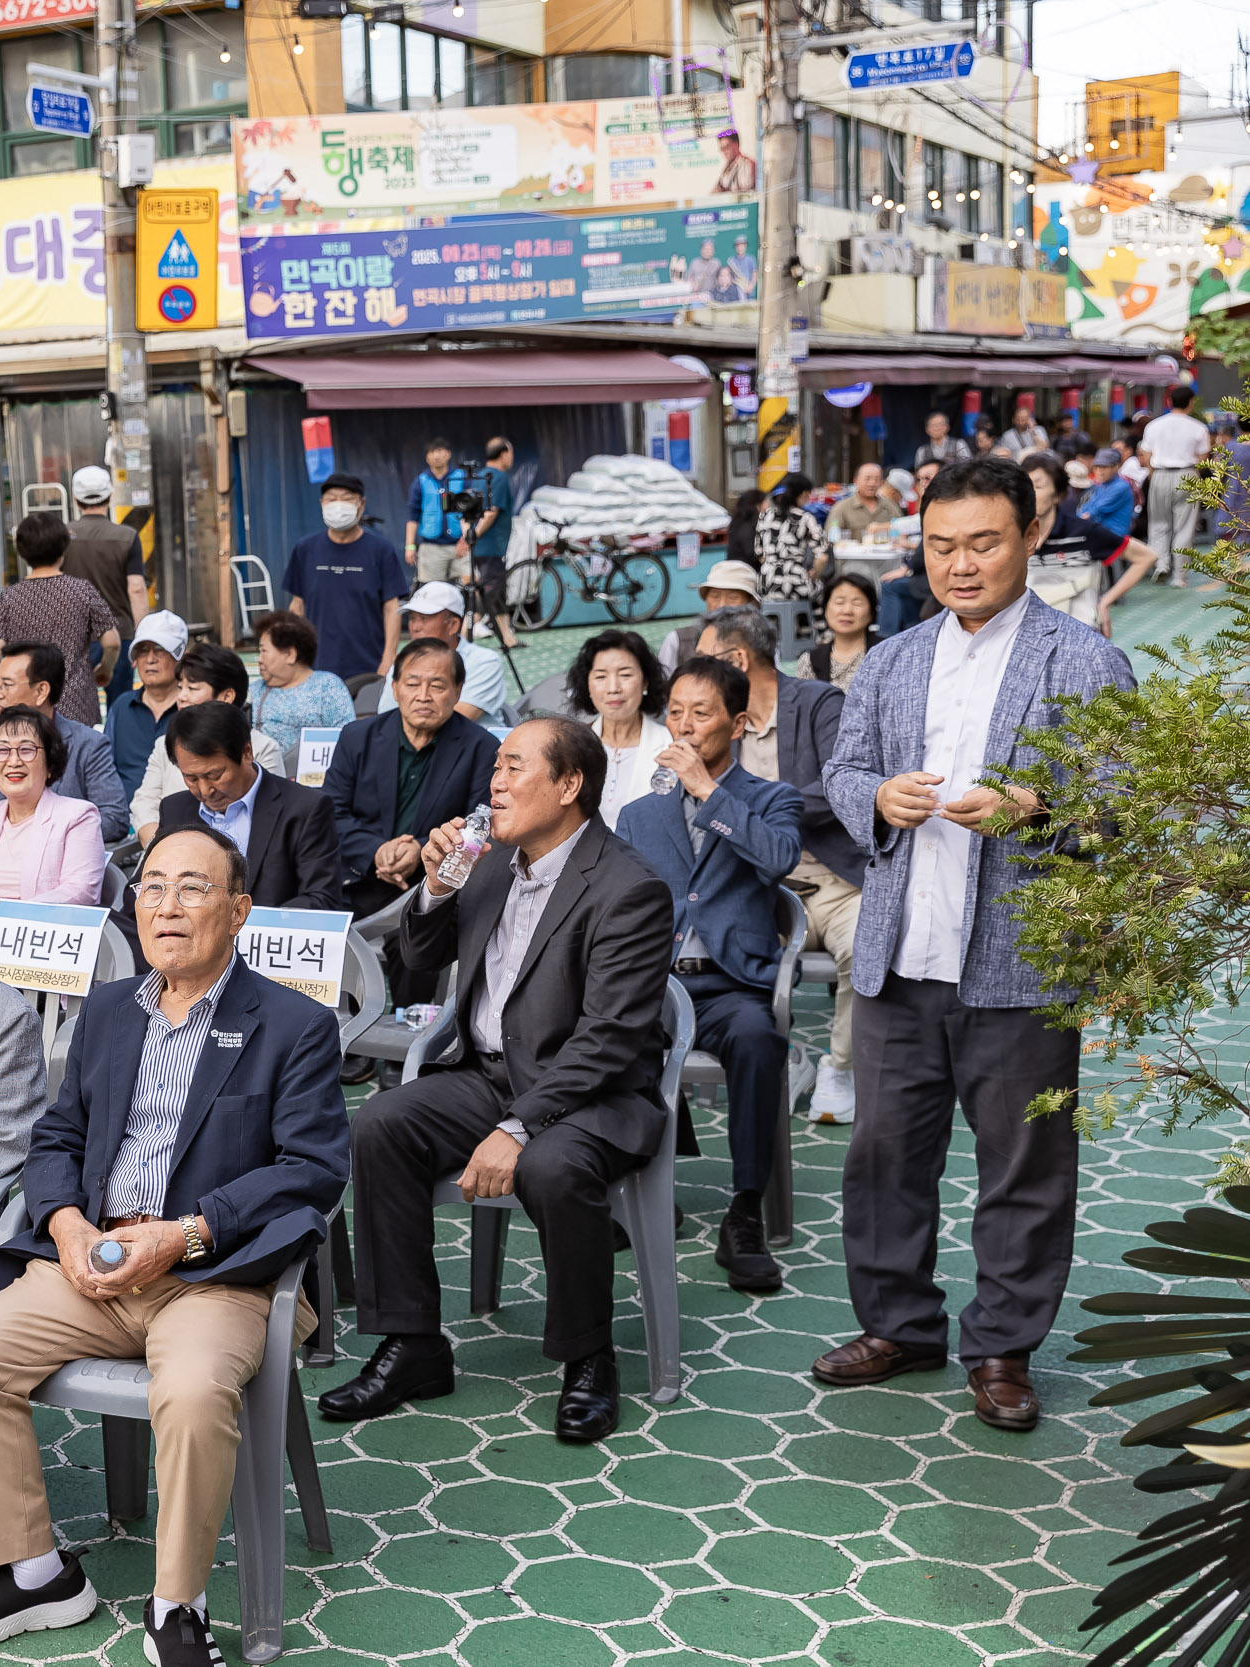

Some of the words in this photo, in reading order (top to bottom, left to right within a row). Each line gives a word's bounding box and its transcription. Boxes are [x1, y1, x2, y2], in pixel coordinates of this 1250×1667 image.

[280, 255, 395, 291] 면곡이랑
[284, 291, 317, 328] 한
[323, 290, 358, 326] 잔
[0, 926, 83, 965] 내빈석
[235, 932, 325, 972] 내빈석
